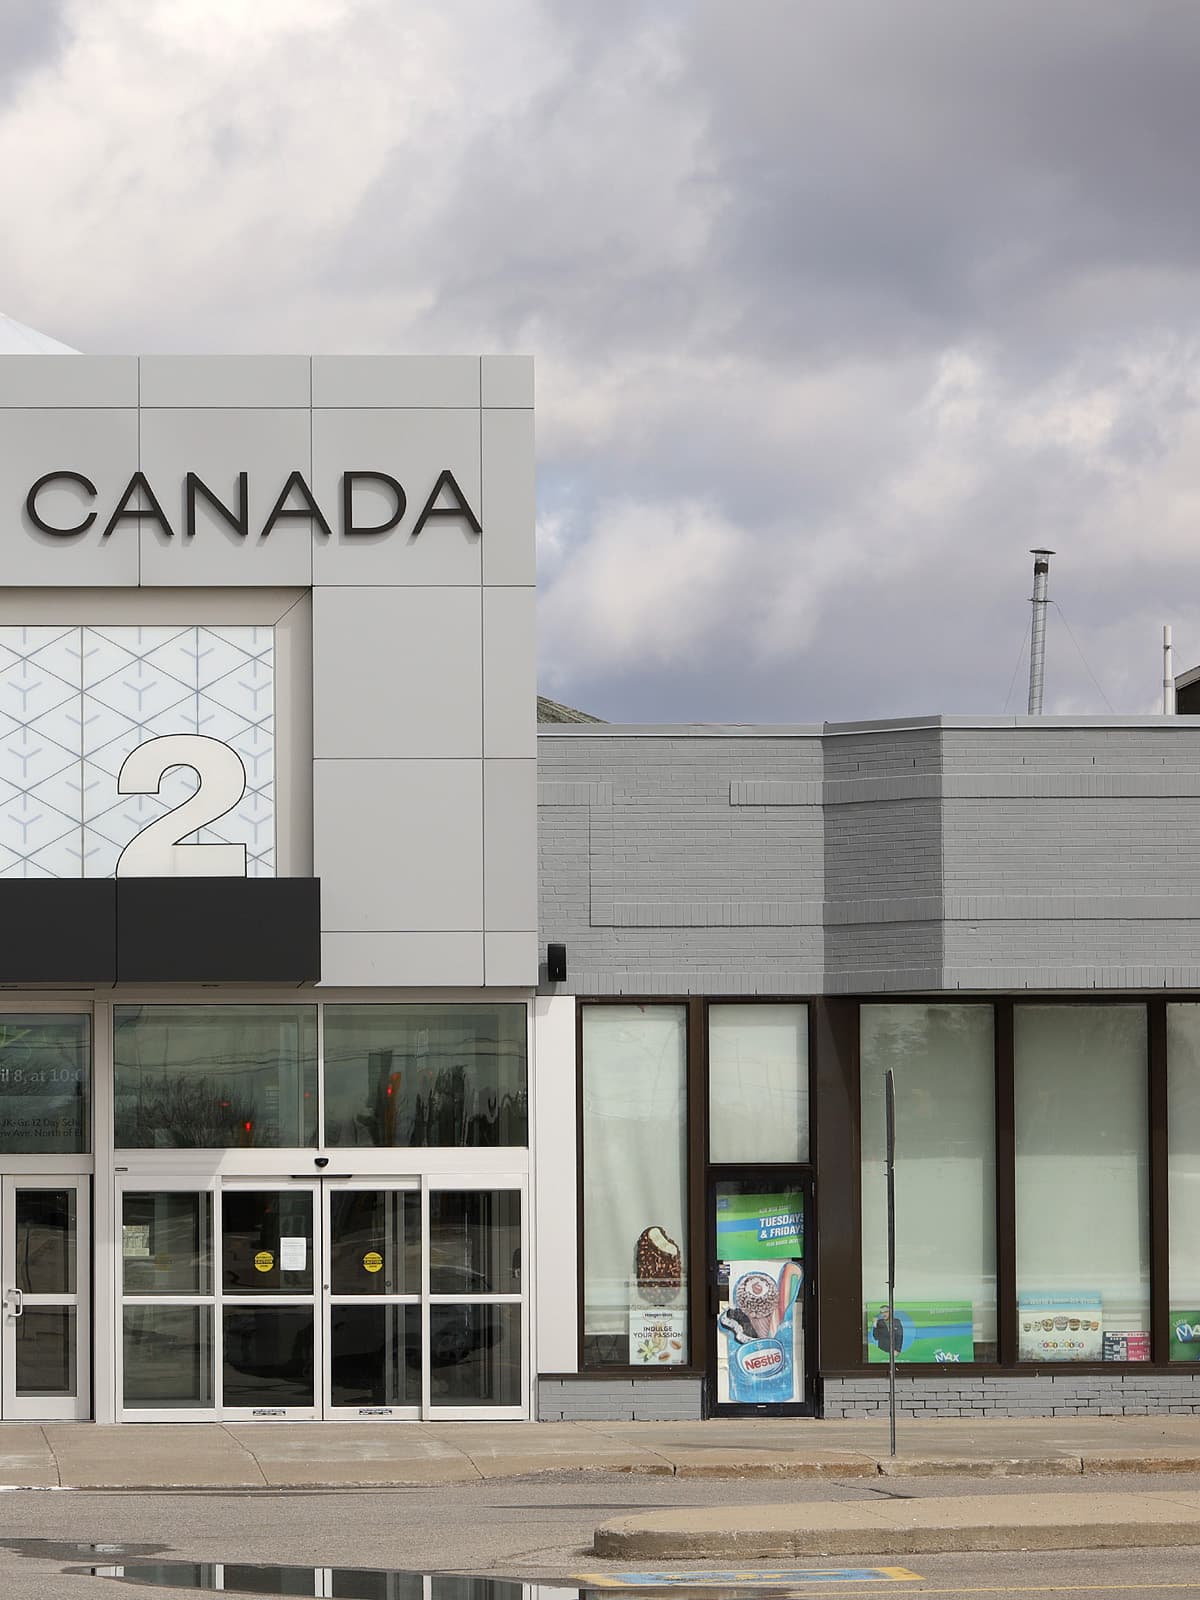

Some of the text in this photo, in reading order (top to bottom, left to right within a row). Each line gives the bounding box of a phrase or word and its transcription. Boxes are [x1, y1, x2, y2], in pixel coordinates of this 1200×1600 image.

[26, 469, 483, 537] CANADA
[116, 733, 248, 879] 2
[31, 1070, 47, 1082] at
[34, 1129, 60, 1137] North
[62, 1128, 73, 1137] of
[760, 1229, 768, 1239] &
